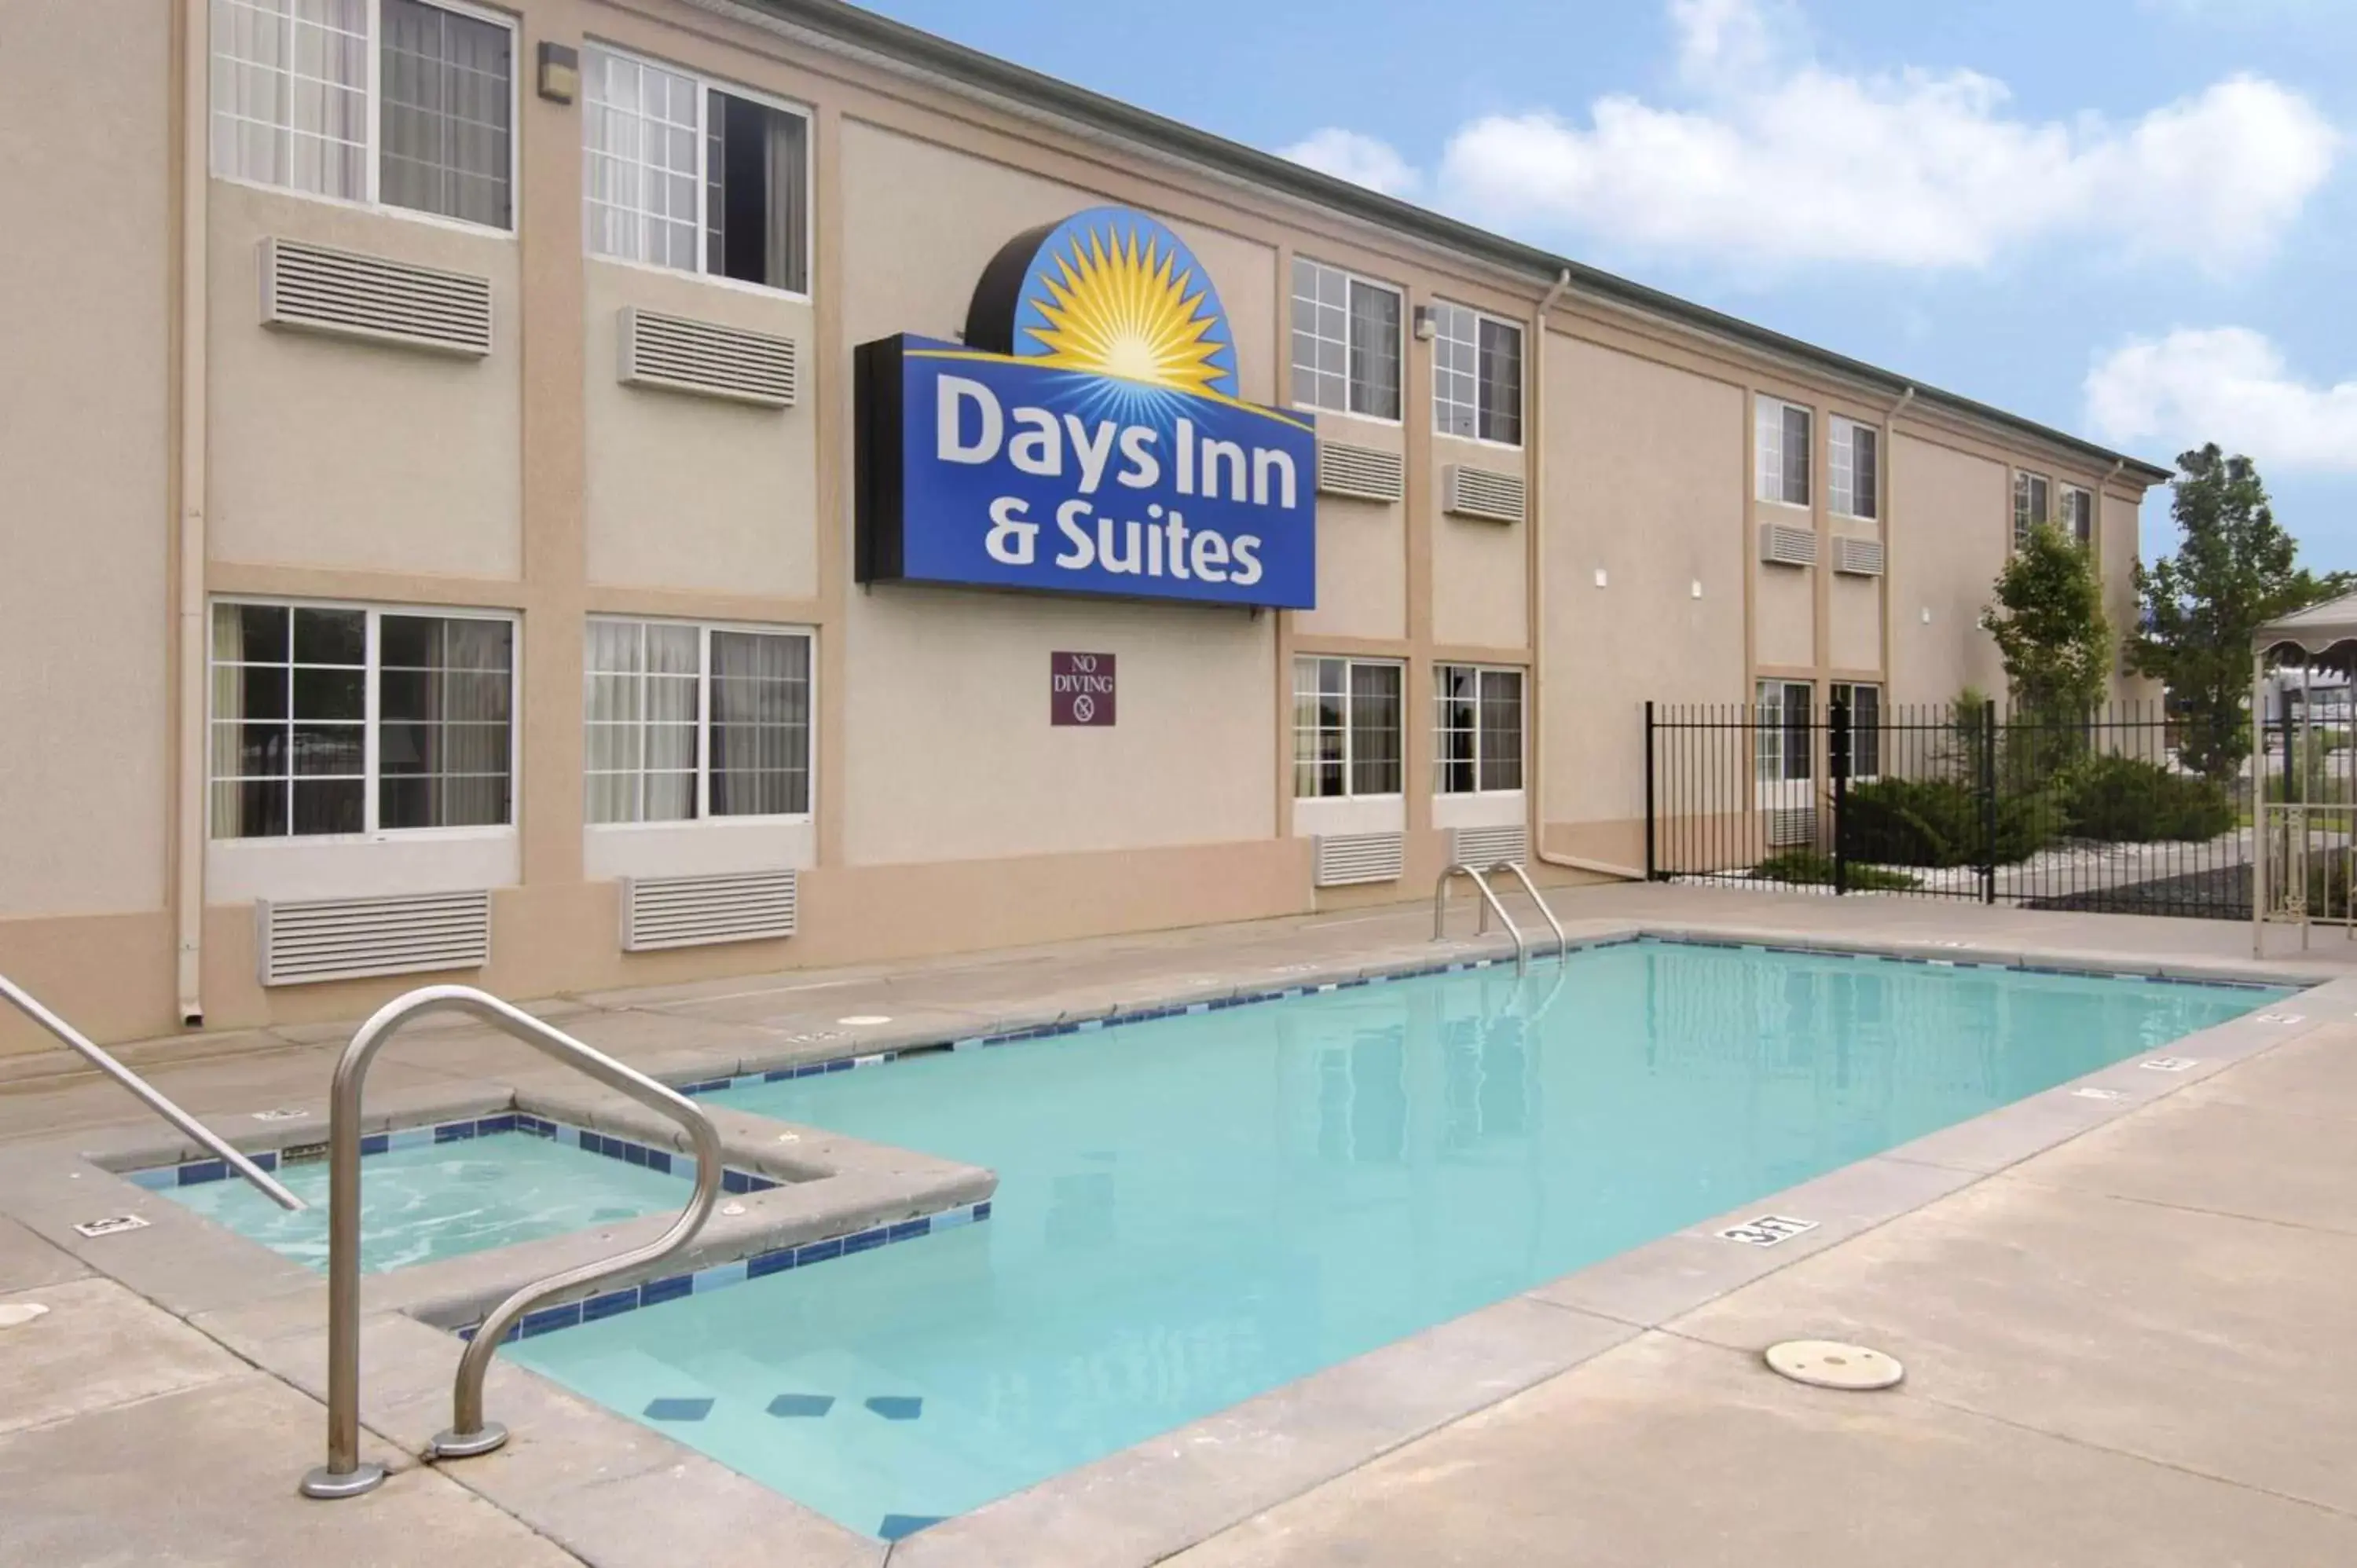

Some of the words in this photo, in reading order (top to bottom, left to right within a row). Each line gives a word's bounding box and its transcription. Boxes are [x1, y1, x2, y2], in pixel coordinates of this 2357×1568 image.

[937, 373, 1160, 493] Days
[1176, 417, 1296, 509] Inn
[984, 496, 1039, 565] &
[1055, 499, 1263, 585] Suites
[1054, 674, 1113, 694] DIVING
[1071, 655, 1097, 673] NO
